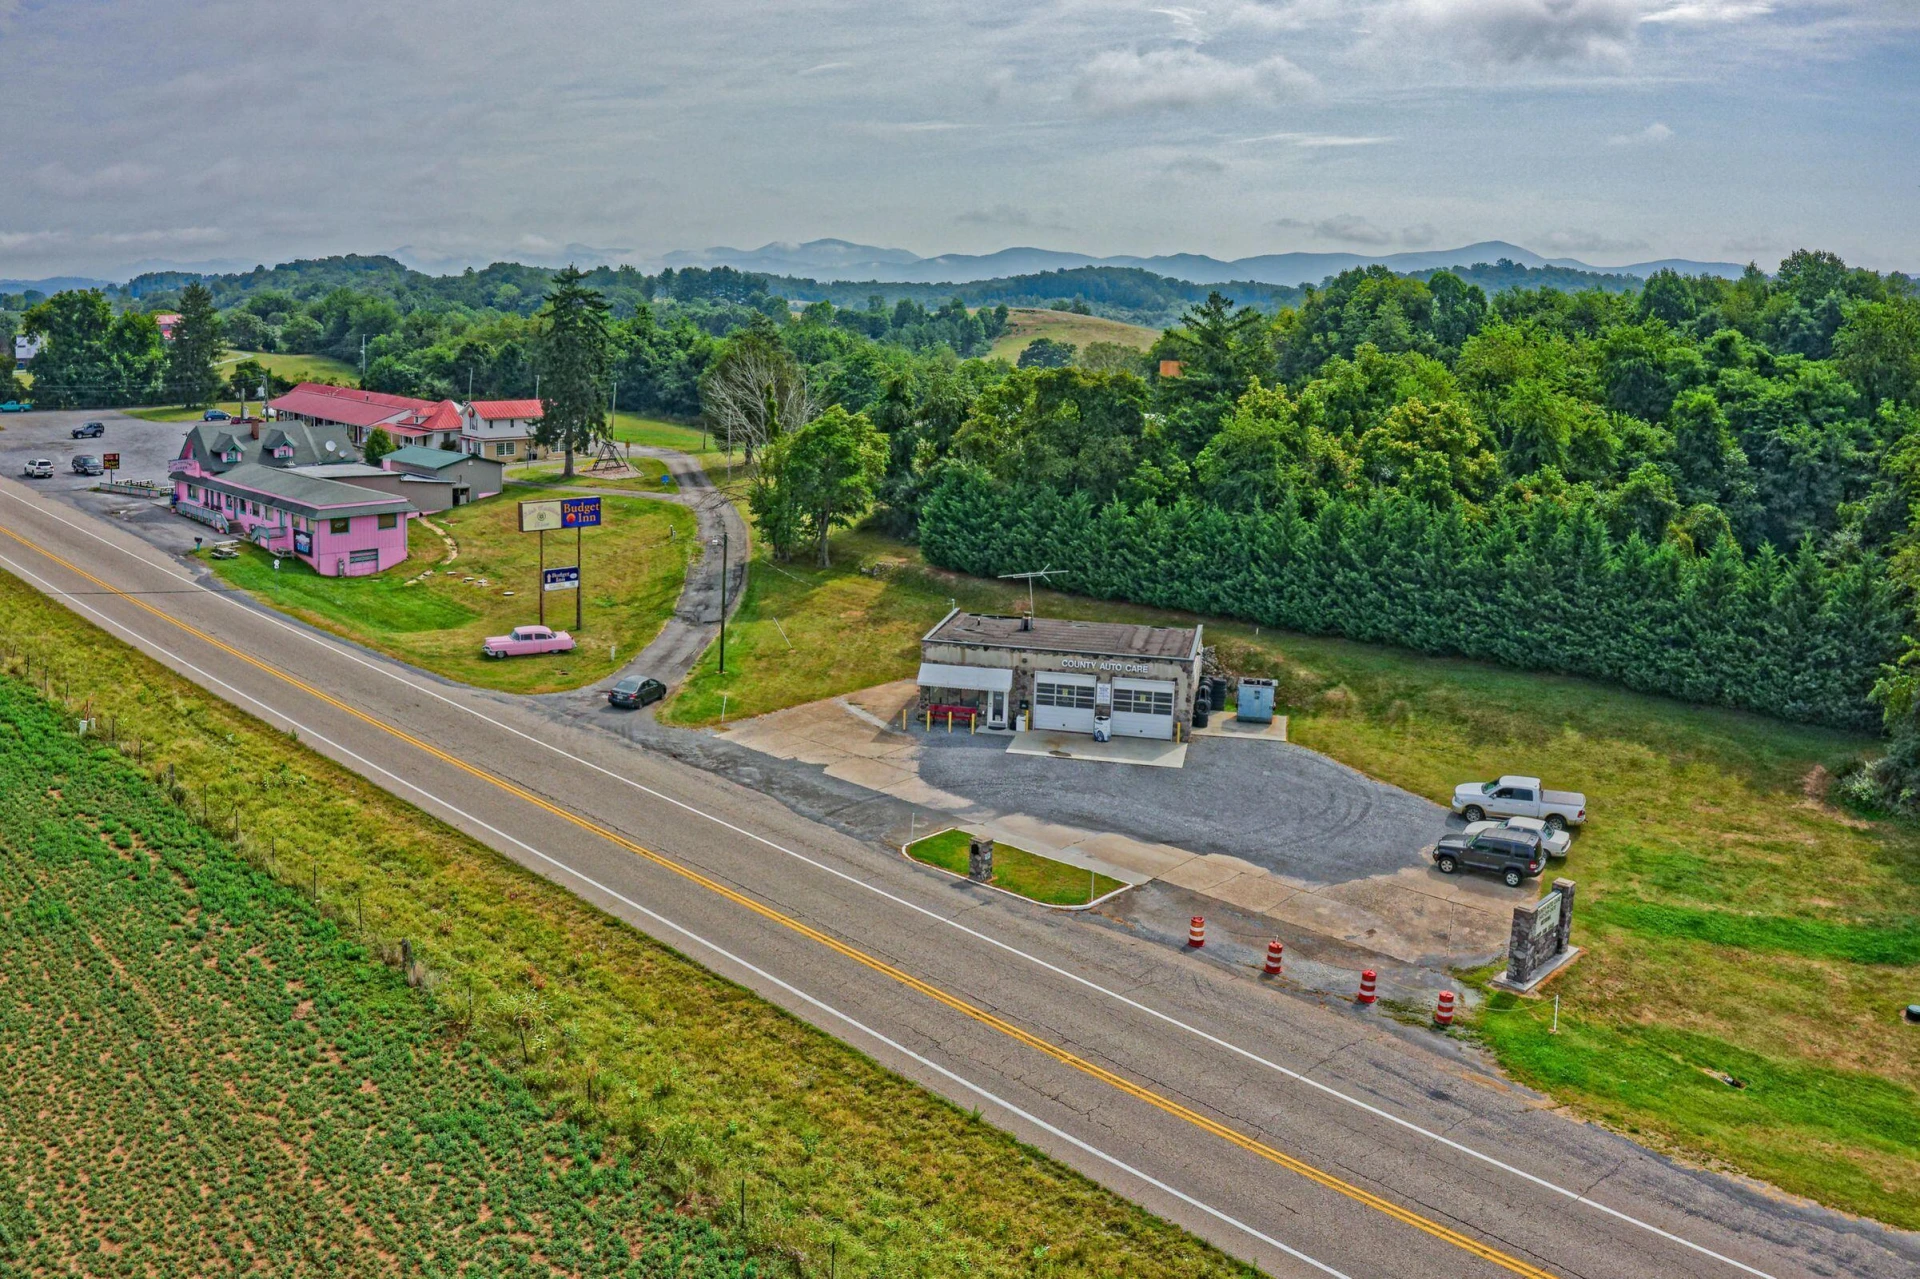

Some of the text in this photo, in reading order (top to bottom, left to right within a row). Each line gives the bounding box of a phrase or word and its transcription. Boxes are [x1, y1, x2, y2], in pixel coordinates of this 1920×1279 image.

[564, 502, 600, 513] Budget
[578, 513, 596, 522] Inn
[1061, 659, 1149, 673] COUNTY AUTO CARE
